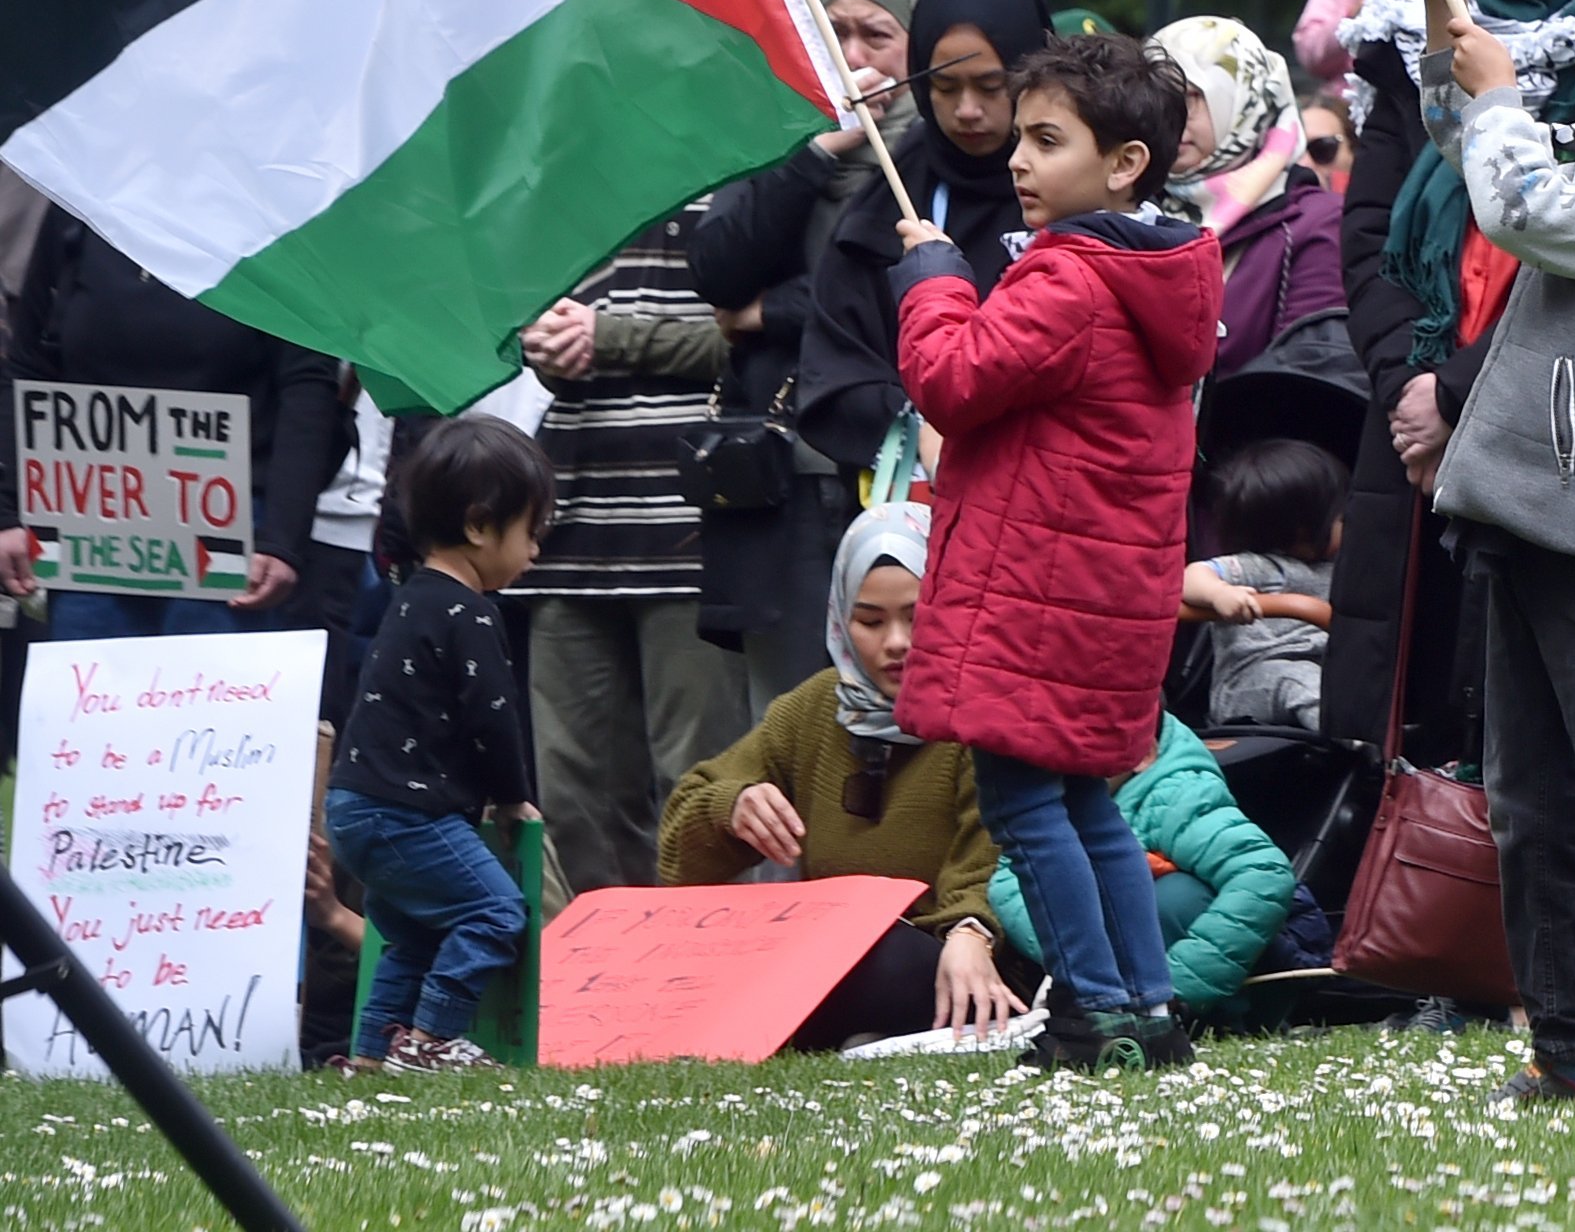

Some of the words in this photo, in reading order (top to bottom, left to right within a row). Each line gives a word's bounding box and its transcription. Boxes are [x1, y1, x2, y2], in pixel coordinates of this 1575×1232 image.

[23, 390, 158, 455] FROM
[168, 406, 231, 443] THE
[25, 458, 151, 519] RIVER
[167, 469, 238, 528] TO
[62, 533, 123, 568] THE
[128, 535, 190, 577] SEA
[70, 661, 121, 723] You
[136, 666, 204, 709] dont
[205, 670, 282, 702] need
[51, 738, 82, 770] to
[100, 742, 128, 770] be
[146, 748, 164, 767] a
[168, 726, 277, 776] Muslim
[42, 791, 70, 823] to
[84, 791, 145, 819] stand
[157, 793, 188, 820] up
[197, 782, 245, 817] for
[48, 829, 228, 875] Palestine
[49, 894, 103, 942] You
[111, 900, 187, 952] just
[193, 898, 275, 932] need
[100, 956, 133, 990] to
[151, 952, 190, 987] be
[46, 973, 263, 1066] HMAN!
